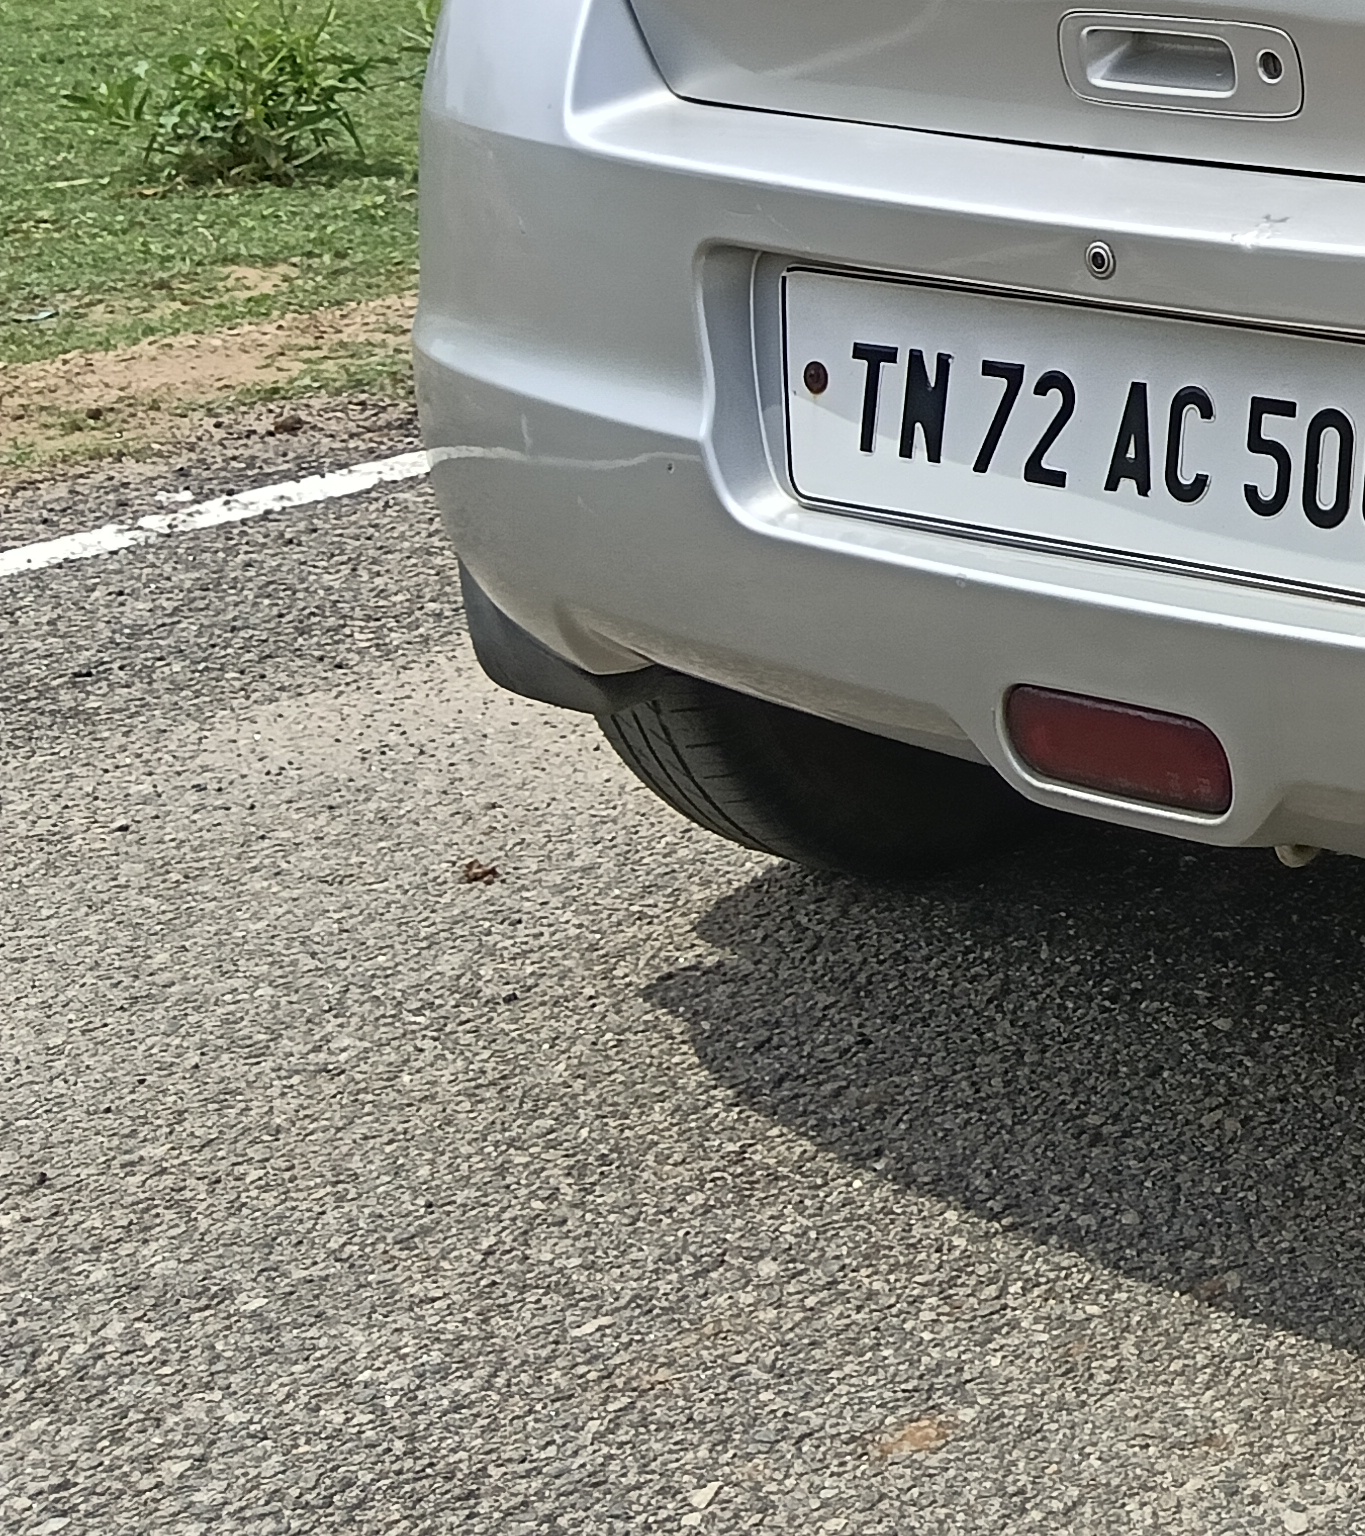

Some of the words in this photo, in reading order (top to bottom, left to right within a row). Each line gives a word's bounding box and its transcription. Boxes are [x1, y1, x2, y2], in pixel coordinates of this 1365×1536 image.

[851, 342, 952, 464] TN
[972, 360, 1076, 489] 72
[1103, 382, 1215, 504] AC
